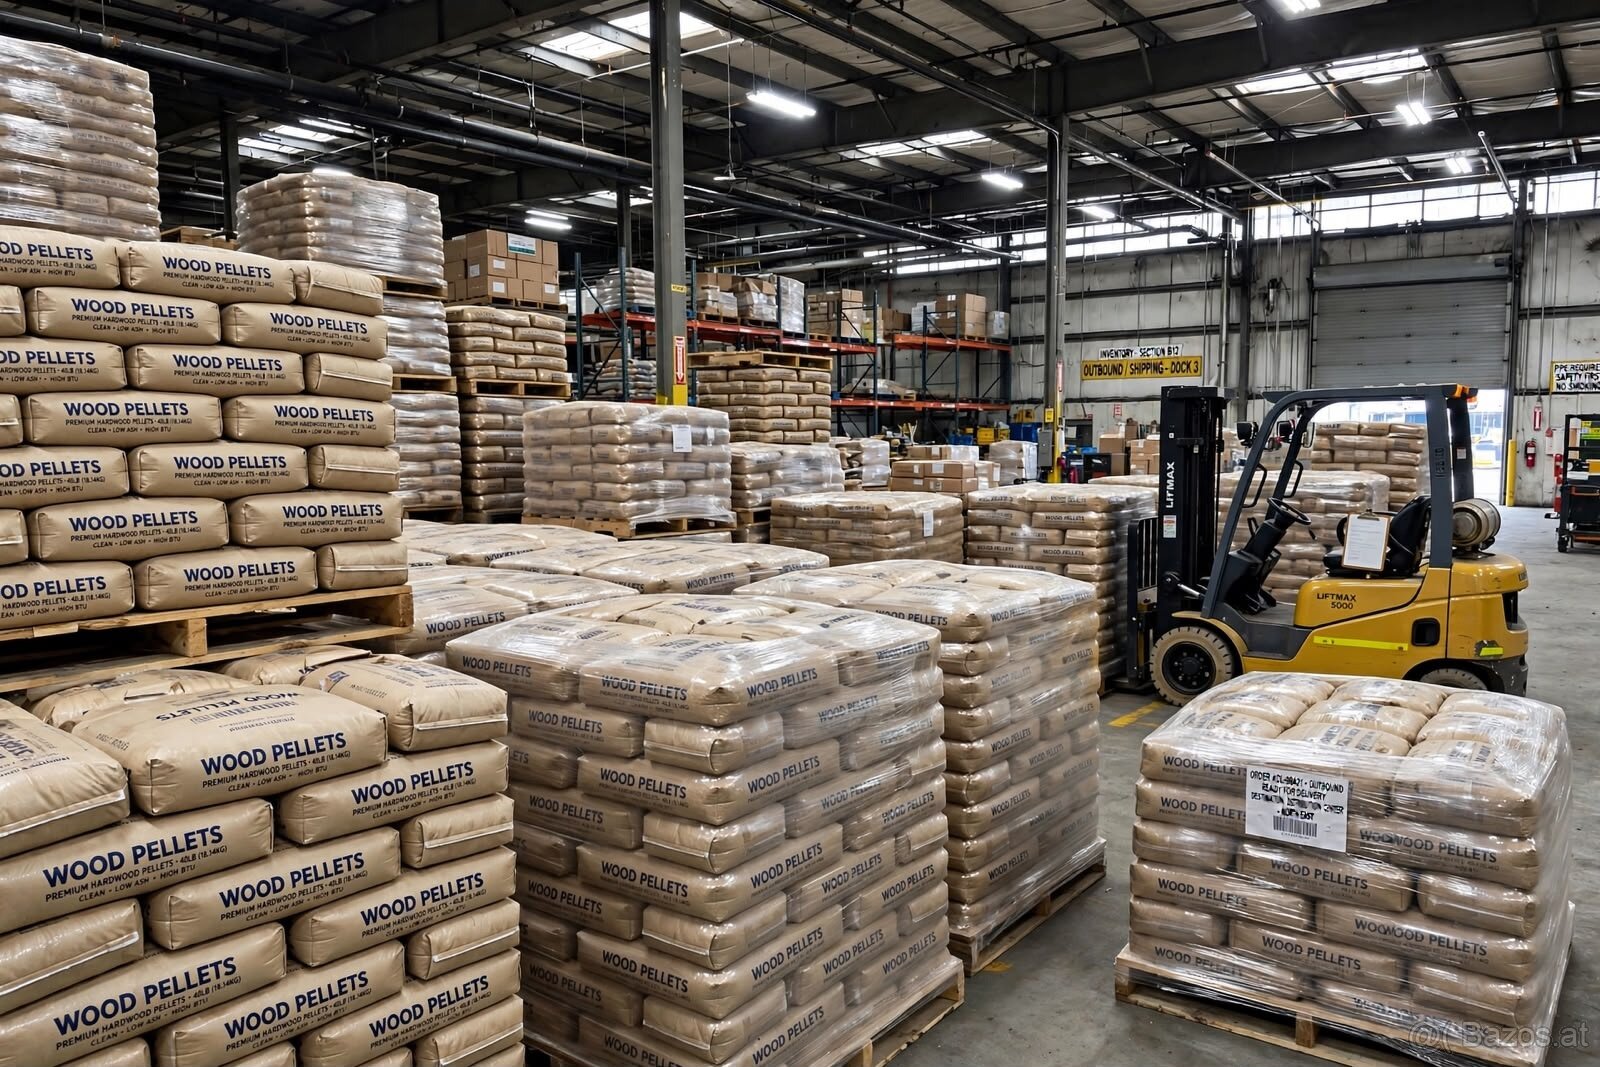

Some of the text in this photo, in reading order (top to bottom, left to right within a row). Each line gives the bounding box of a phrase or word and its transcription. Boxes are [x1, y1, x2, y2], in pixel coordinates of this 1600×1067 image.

[0, 242, 93, 261] OD PELLETS
[162, 256, 271, 278] WOOD PELLETS
[71, 298, 194, 319] WOOD PELLETS
[270, 312, 367, 334] WOOD PELLETS
[0, 351, 95, 365] OD PELLETS
[173, 355, 282, 371] WOOD PELLETS
[1100, 348, 1134, 358] INVENTORY
[1140, 346, 1165, 357] SECTION
[1083, 363, 1123, 377] OUTBOUND
[1129, 362, 1164, 375] SHIPPING
[1170, 360, 1192, 374] DOCK
[1193, 360, 1199, 373] 3
[1554, 364, 1568, 372] PPE
[1556, 382, 1566, 390] NO
[64, 403, 188, 416] WOOD PELLETS
[274, 405, 373, 422] WOOD PELLETS
[0, 460, 101, 477] OD PELLETS
[174, 456, 286, 469] WOOD PELLETS
[69, 510, 198, 532] WOOD PELLETS
[282, 504, 383, 518] WOOD PELLETS
[183, 561, 295, 582] WOOD PELLETS
[1, 576, 106, 599] OD PELLETS
[1316, 592, 1357, 602] LIFTMAX
[1330, 602, 1354, 610] 5000
[425, 611, 506, 634] WOOD PELLETS
[908, 611, 948, 626] PELLETS
[462, 655, 532, 678] WOOD PELLETS
[601, 674, 687, 701] WOOD PELLETS
[747, 668, 817, 698] WOOD PELLETS
[528, 709, 603, 733] WOOD PELLETS
[991, 727, 1032, 752] WOOD PELLETS
[200, 732, 346, 775] WOOD PELLETS
[1163, 754, 1199, 769] WOOD
[202, 760, 307, 788] PREMIUM HARDWOOD PELLETS
[351, 761, 474, 805] WOOD PELLETS
[600, 767, 687, 799] WOOD PELLETS
[747, 755, 820, 794] WOOD PELLETS
[1250, 770, 1270, 781] ORDER
[1160, 796, 1197, 812] WOOD
[1297, 789, 1326, 801] DELIVERY
[529, 795, 603, 824] WOOD PELLETS
[43, 825, 223, 888] WOOD PELLETS
[1438, 841, 1497, 863] PELLETS
[751, 842, 823, 889] WOOD PELLETS
[822, 853, 882, 894] WOOD PELLETS
[1270, 859, 1368, 890] WOOD PELLETS
[45, 884, 89, 902] PREMIUM
[91, 869, 140, 889] HARDWOOD
[142, 860, 174, 875] PELLETS
[78, 889, 106, 902] CLEAN
[114, 882, 132, 893] LOW
[134, 877, 149, 888] ASH
[181, 864, 196, 875] BTU
[219, 852, 364, 908] WOOD PELLETS
[601, 860, 688, 897] WOOD PELLETS
[881, 864, 935, 902] WOOD PELLETS
[361, 872, 483, 926] WOOD PELLETS
[528, 879, 602, 914] WOOD PELLETS
[1158, 877, 1248, 907] WOOD PELLETS
[751, 927, 823, 981] WOOD PELLETS
[823, 928, 883, 975] WOOD PELLETS
[882, 931, 936, 975] WOOD PELLETS
[1155, 945, 1191, 965] WOOD
[1262, 935, 1361, 970] WOOD PELLETS
[1428, 935, 1488, 956] PELLETS
[529, 963, 602, 1001] WOOD PELLETS
[602, 949, 688, 993] WOOD PELLETS
[53, 957, 236, 1036] WOOD PELLETS
[224, 971, 368, 1039] WOOD PELLETS
[369, 976, 489, 1038] WOOD PELLETS
[56, 995, 186, 1051] PREMIUM HARDWOOD PELLETS
[752, 1005, 824, 1065] WOOD PELLETS
[604, 1034, 638, 1058] WOOD
